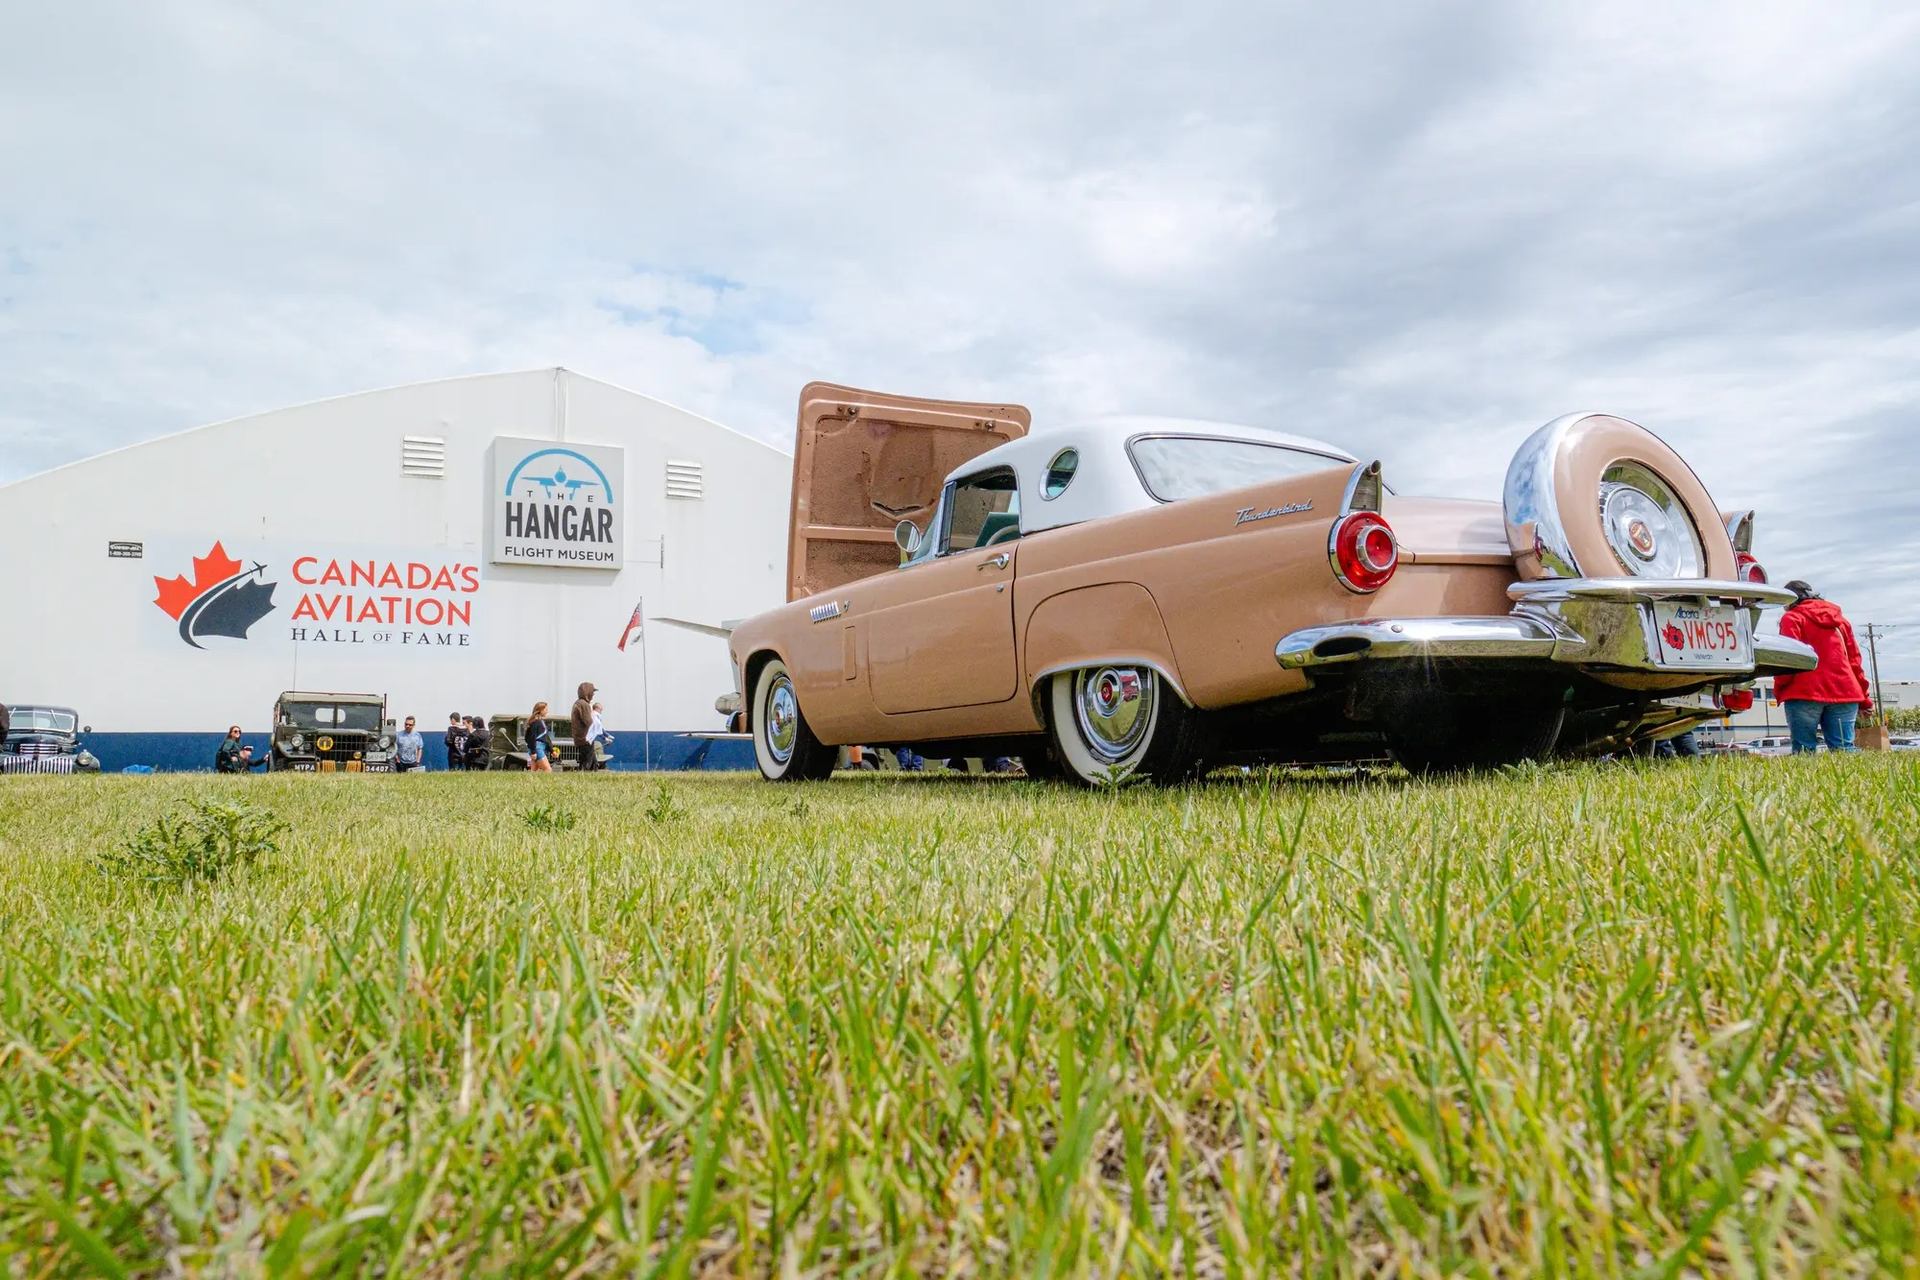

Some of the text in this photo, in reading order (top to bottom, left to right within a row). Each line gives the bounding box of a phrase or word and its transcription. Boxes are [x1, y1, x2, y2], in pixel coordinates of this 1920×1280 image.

[527, 491, 594, 502] THE
[505, 501, 613, 543] HANGAR
[1233, 498, 1314, 527] Thunderbird
[505, 546, 614, 562] FLIGHT MUSEUM
[292, 556, 479, 593] CANADA'S
[291, 593, 471, 626] AVIATION
[290, 627, 470, 646] HALL OF FAME
[1684, 620, 1737, 652] VMC95
